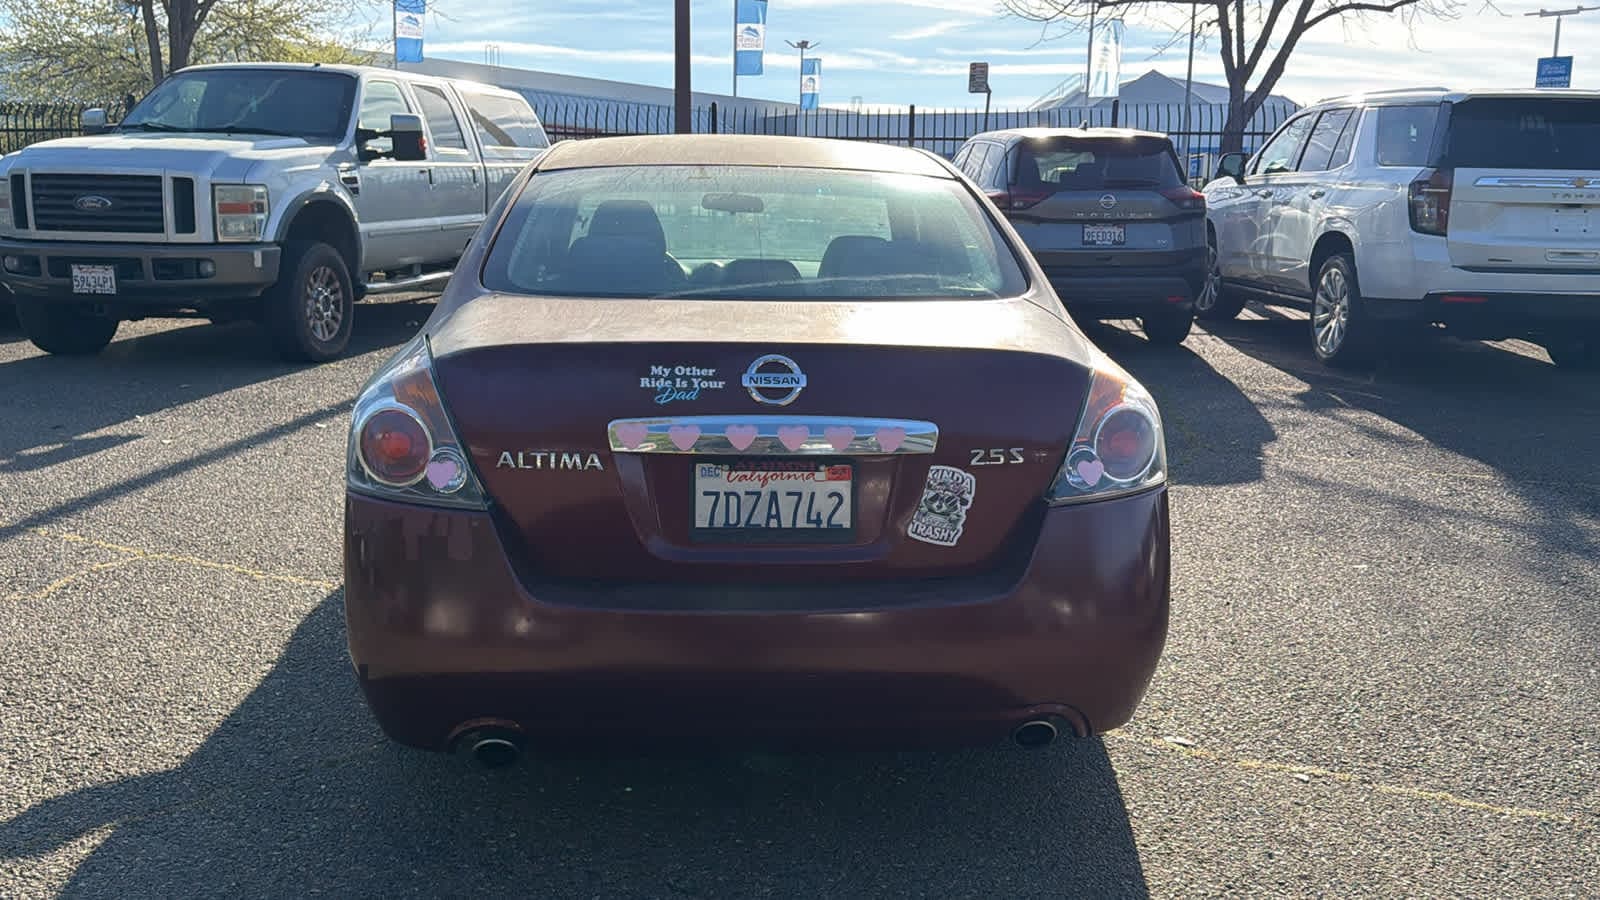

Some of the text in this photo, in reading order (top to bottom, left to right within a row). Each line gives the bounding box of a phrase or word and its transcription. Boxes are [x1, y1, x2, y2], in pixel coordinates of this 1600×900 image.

[650, 366, 716, 377] My Other
[749, 376, 800, 385] NISSAN
[640, 377, 726, 389] Ride Is Your
[655, 385, 700, 405] Dad
[496, 451, 604, 471] ALTIMA
[700, 466, 721, 477] DEC
[726, 470, 816, 489] California
[928, 468, 972, 494] KINDA
[702, 490, 845, 528] 7DZA742
[912, 521, 958, 543] TRASHY
